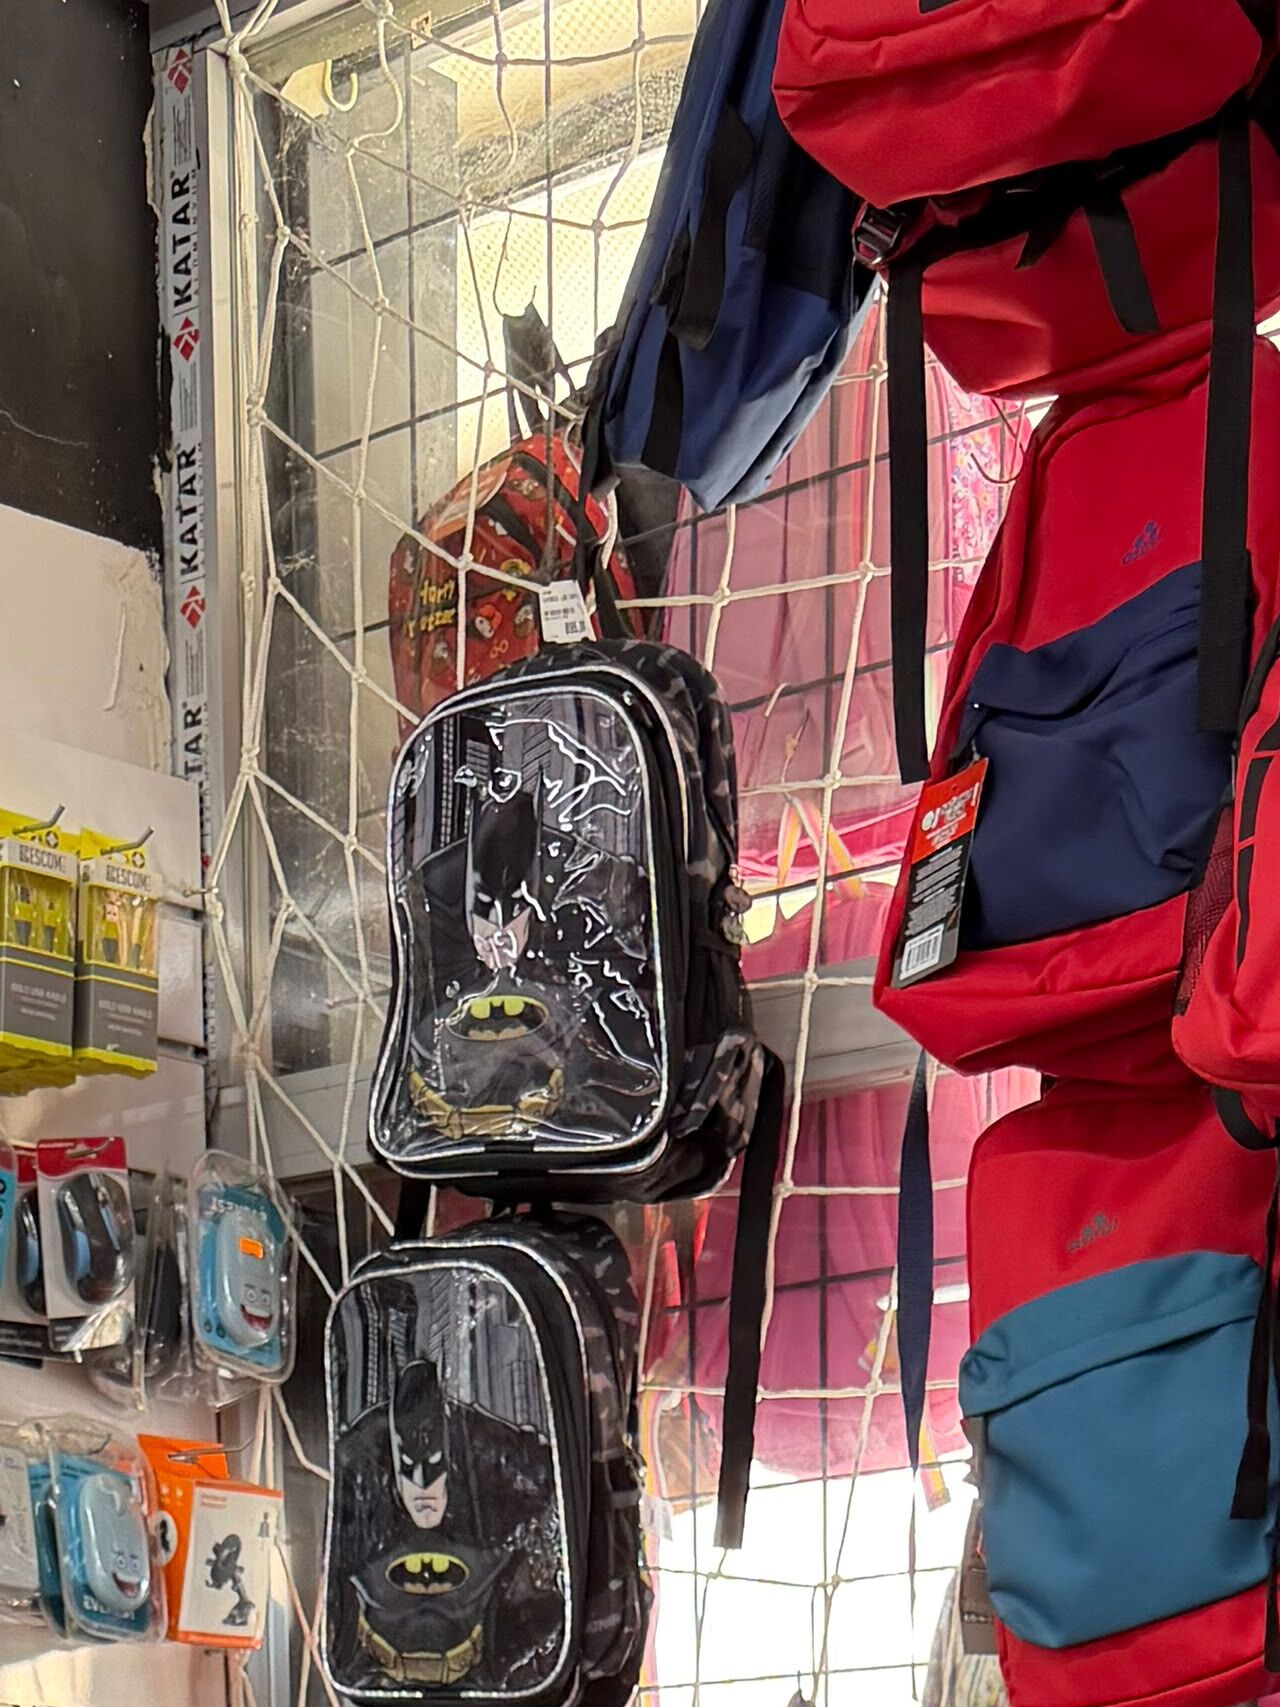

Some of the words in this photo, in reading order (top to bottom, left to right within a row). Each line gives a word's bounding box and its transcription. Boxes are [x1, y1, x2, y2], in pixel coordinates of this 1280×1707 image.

[173, 174, 191, 308] KATAR
[178, 444, 201, 574] KATAR
[184, 702, 204, 777] TAR
